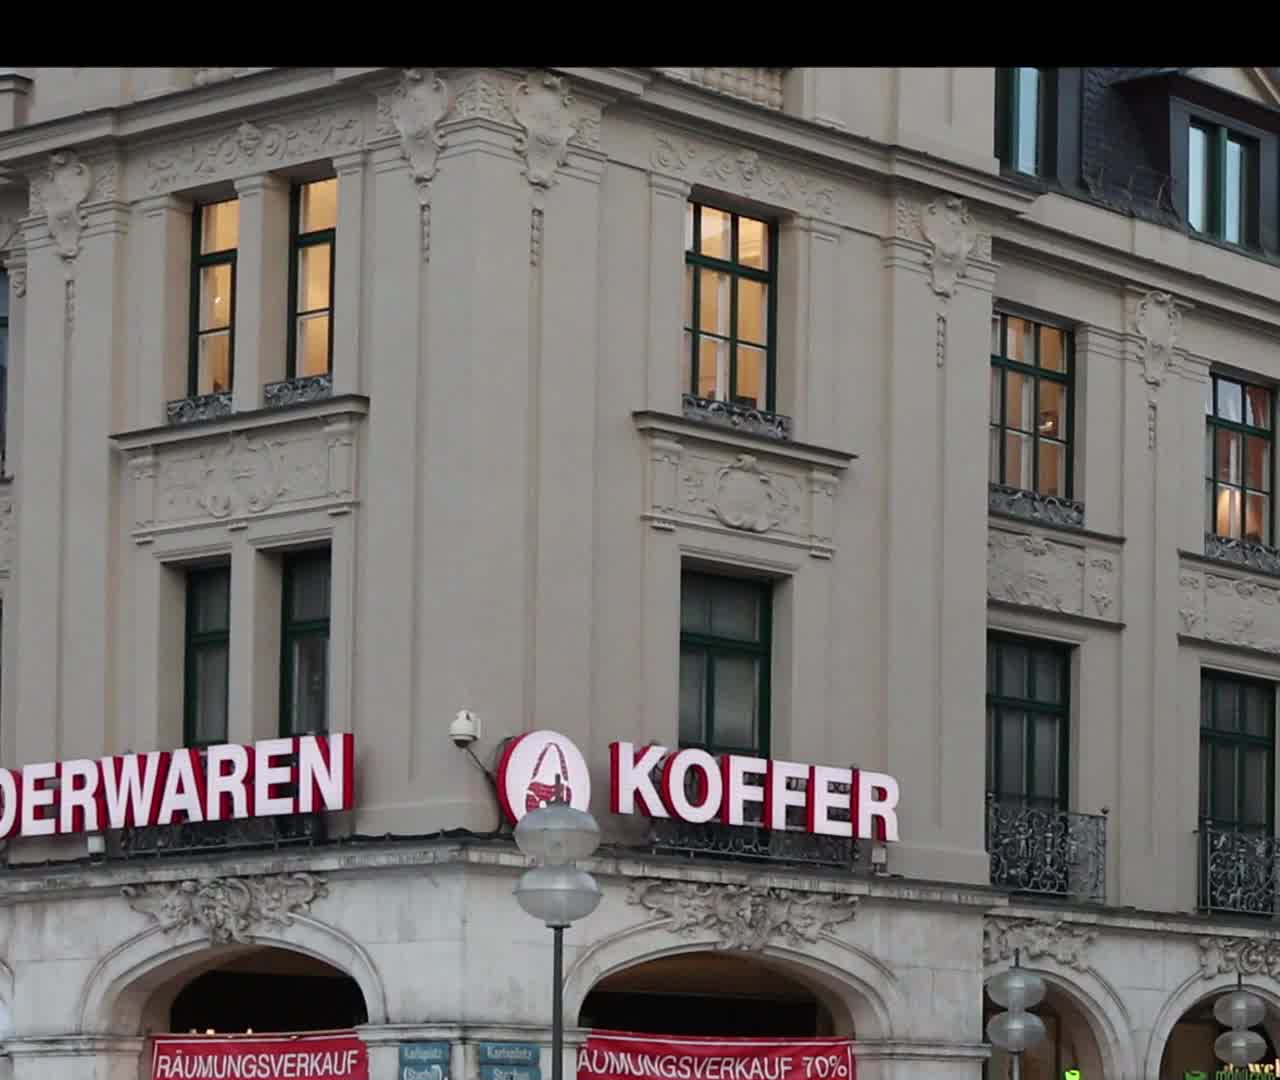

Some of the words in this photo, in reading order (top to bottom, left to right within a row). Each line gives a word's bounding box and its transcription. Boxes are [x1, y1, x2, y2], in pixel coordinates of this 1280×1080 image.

[611, 741, 900, 842] KOFFER
[156, 1050, 358, 1079] RÄUMUNGSVERKAUF
[802, 1055, 848, 1078] 70%
